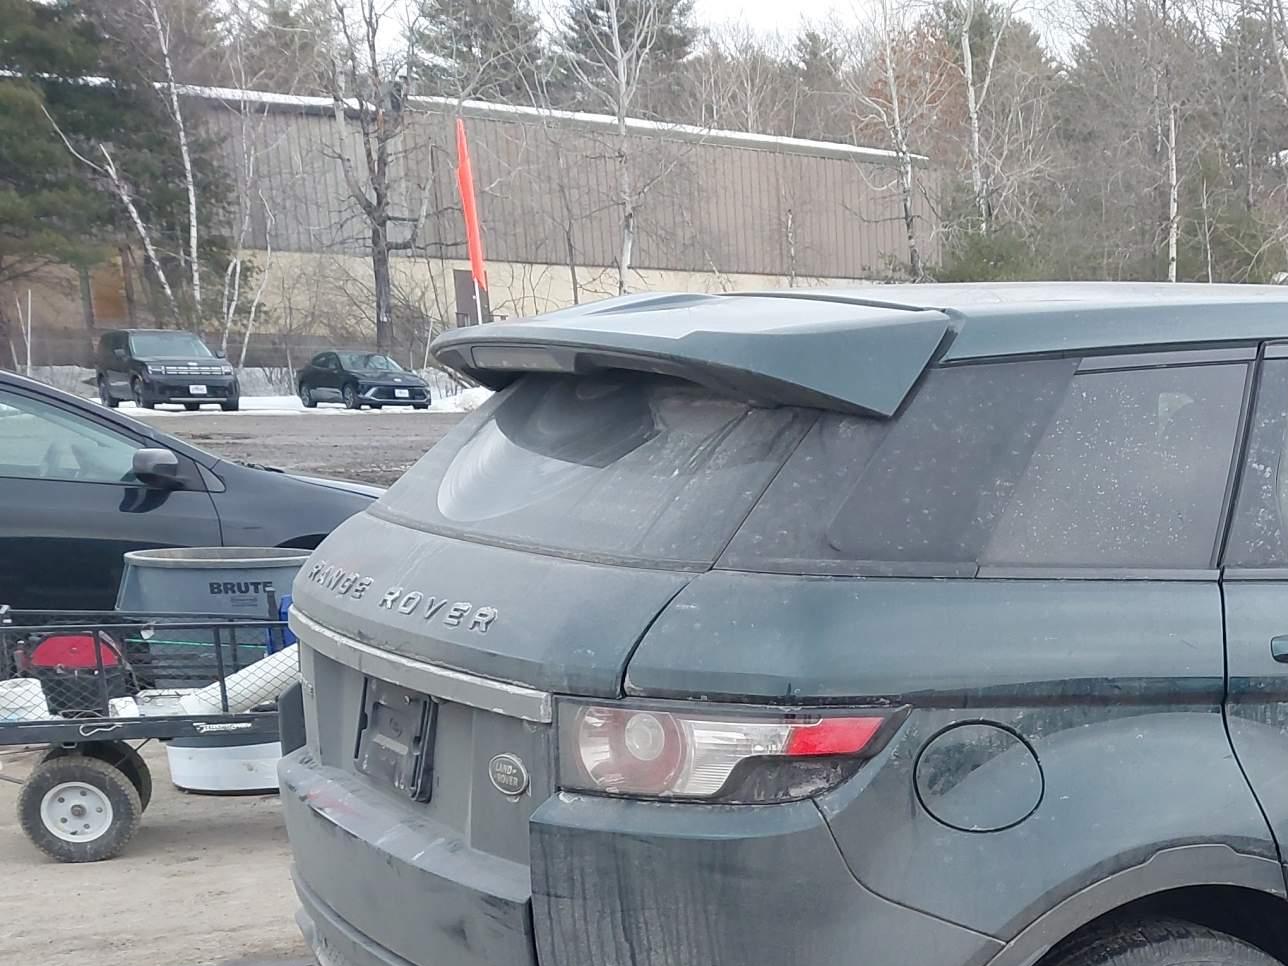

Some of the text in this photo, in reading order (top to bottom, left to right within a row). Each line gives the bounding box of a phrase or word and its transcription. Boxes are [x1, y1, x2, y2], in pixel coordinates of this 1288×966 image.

[209, 581, 273, 594] BRUTE
[308, 560, 498, 633] RANGE ROVER
